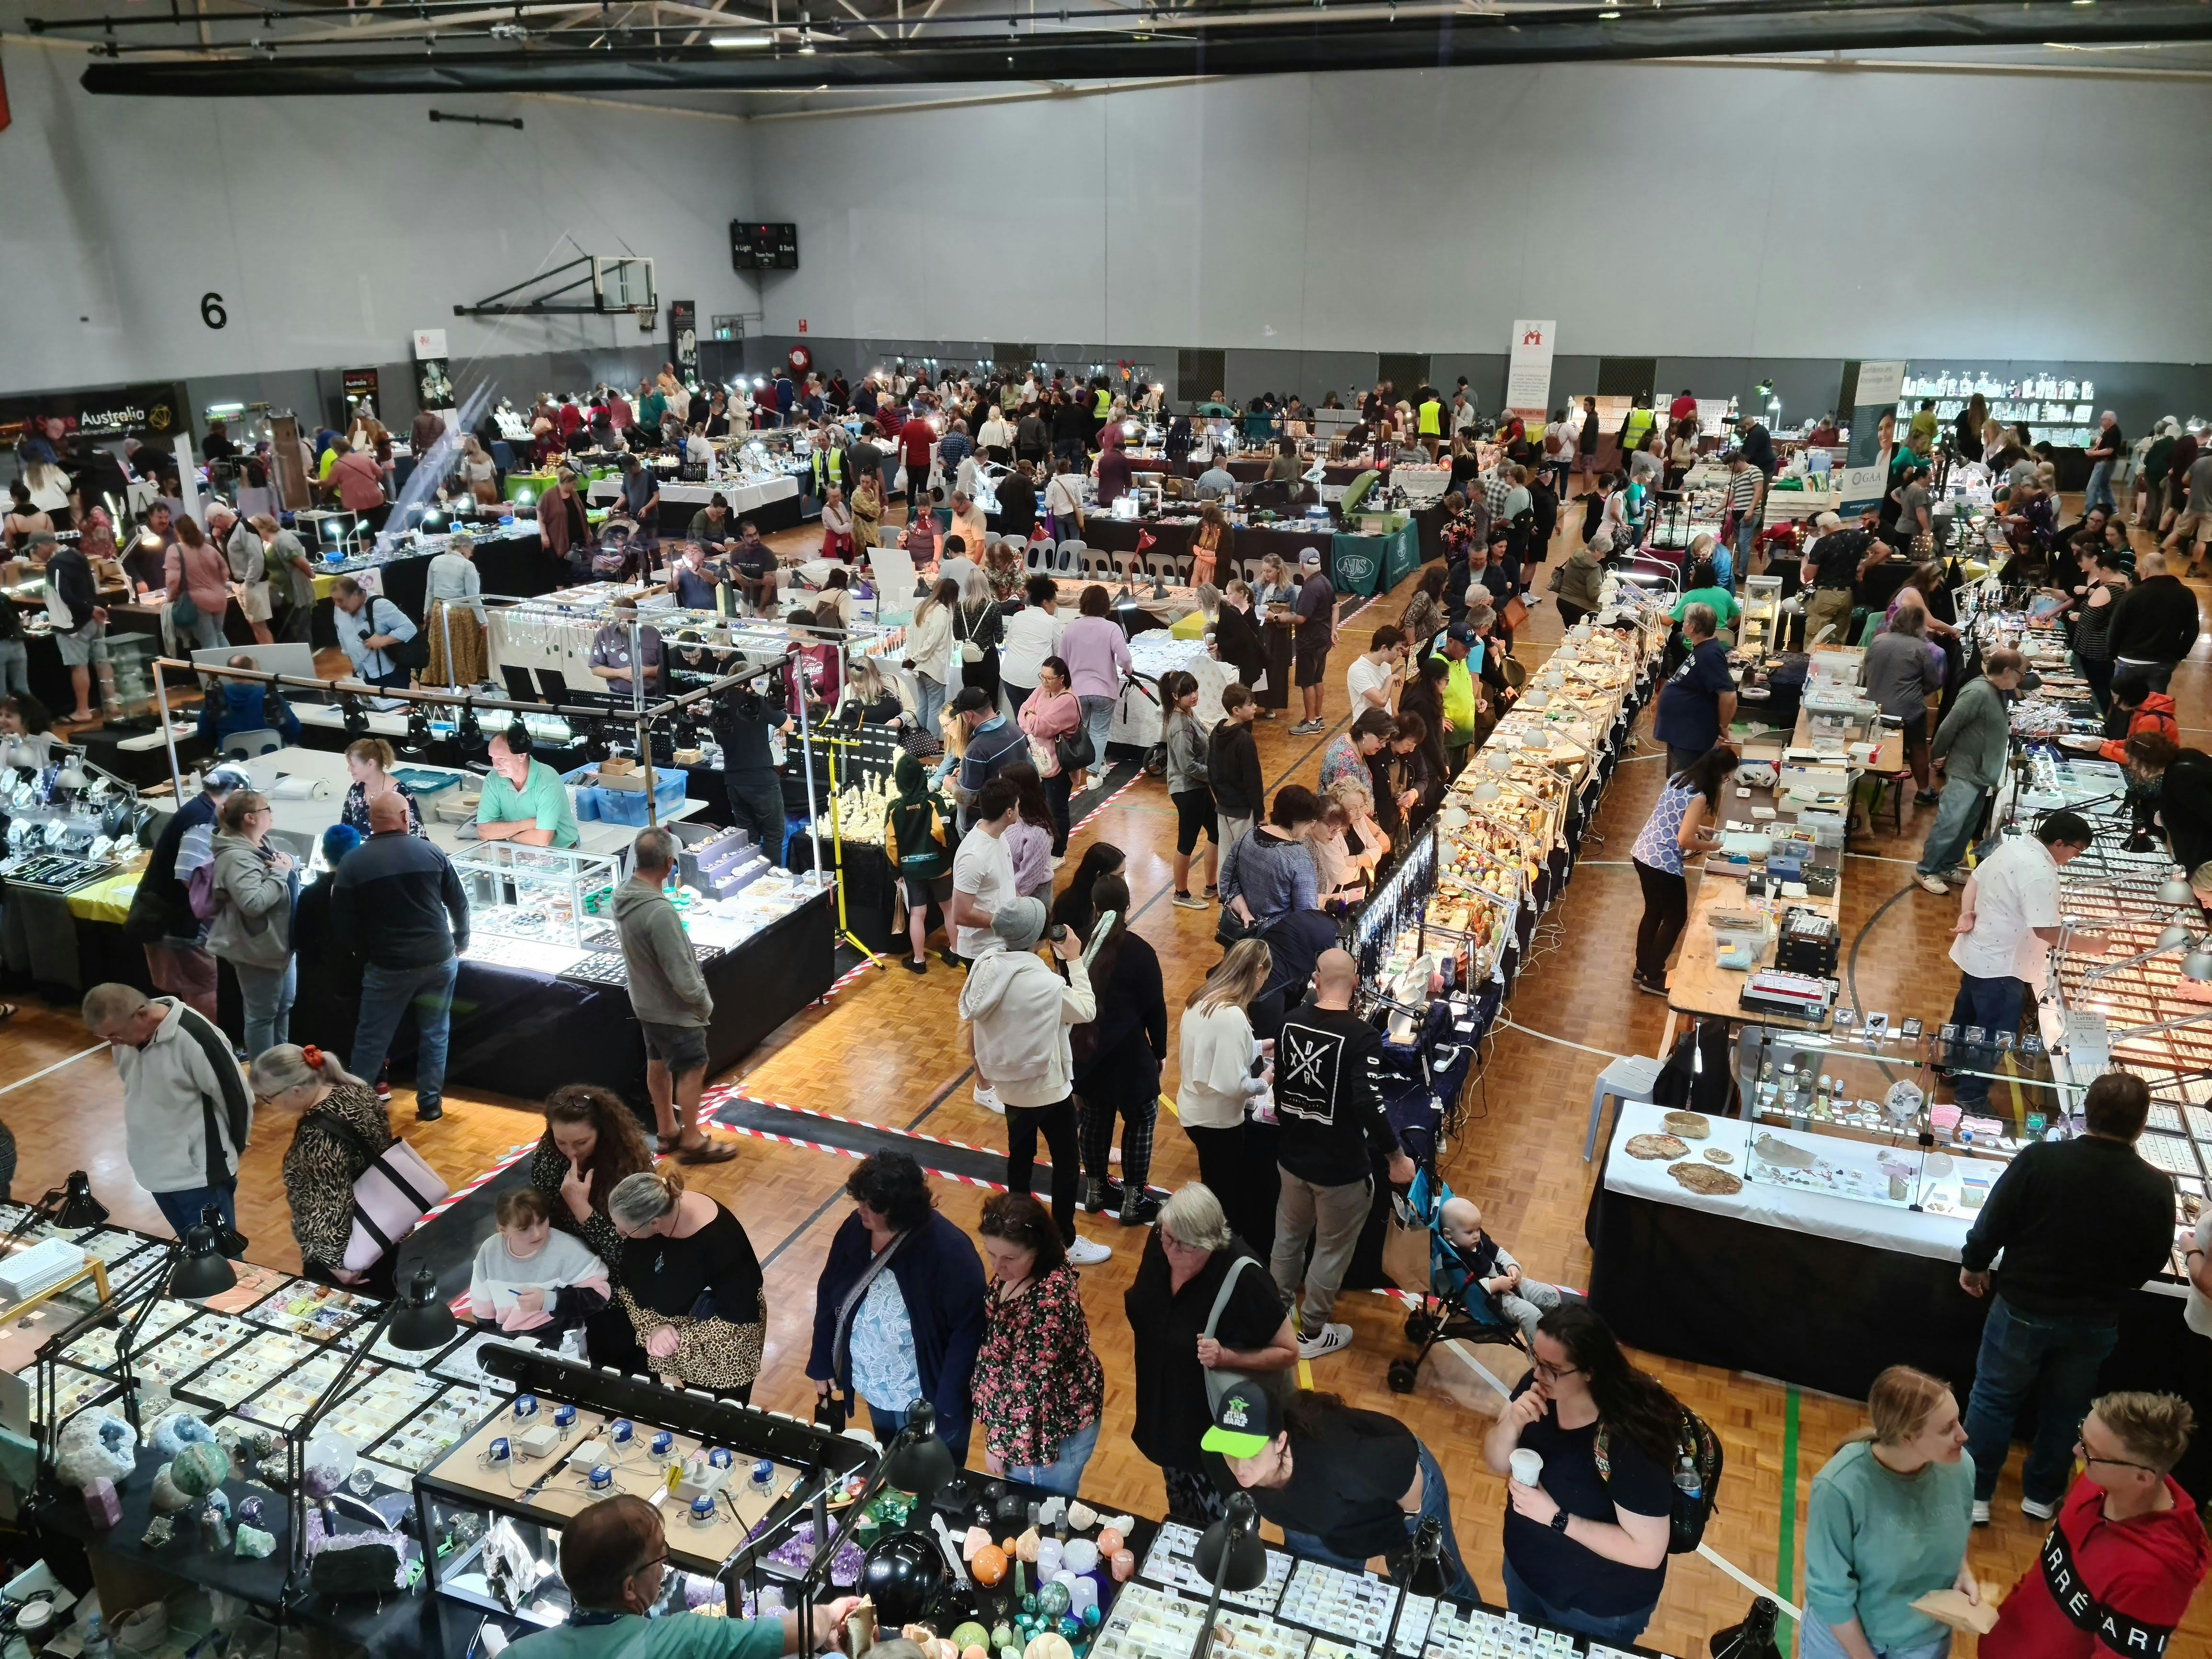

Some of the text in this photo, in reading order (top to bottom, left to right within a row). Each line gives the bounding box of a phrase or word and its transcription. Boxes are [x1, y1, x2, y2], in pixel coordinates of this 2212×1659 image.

[201, 293, 227, 330] 6
[81, 406, 145, 426] Australia
[1862, 471, 1881, 483] GAA
[1342, 558, 1367, 576] AJS
[1223, 1410, 1248, 1421] STAR
[1223, 1416, 1247, 1427] WARS
